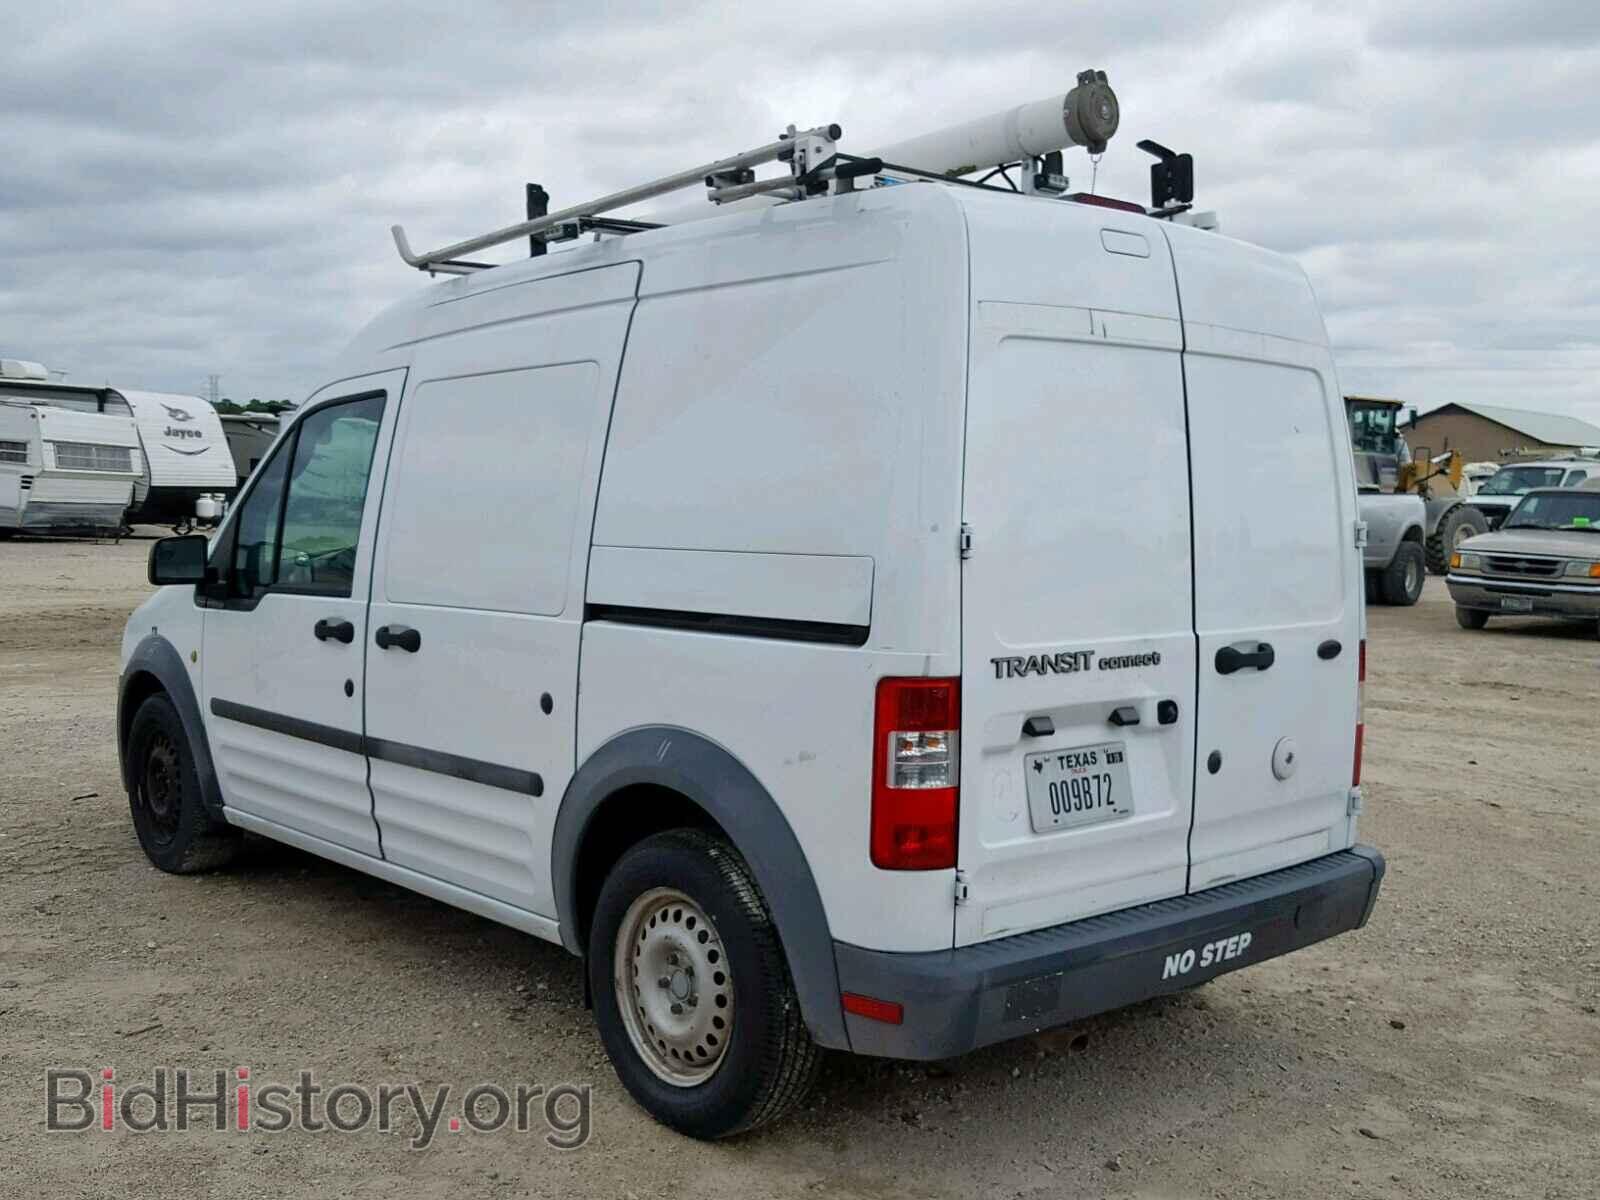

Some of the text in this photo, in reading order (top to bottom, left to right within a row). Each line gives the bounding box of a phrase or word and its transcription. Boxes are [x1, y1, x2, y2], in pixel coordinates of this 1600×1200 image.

[990, 649, 1161, 679] TRANSIT connect
[1057, 751, 1098, 770] TEXAS
[1049, 772, 1115, 815] 009B72
[1161, 931, 1253, 980] NO STEP
